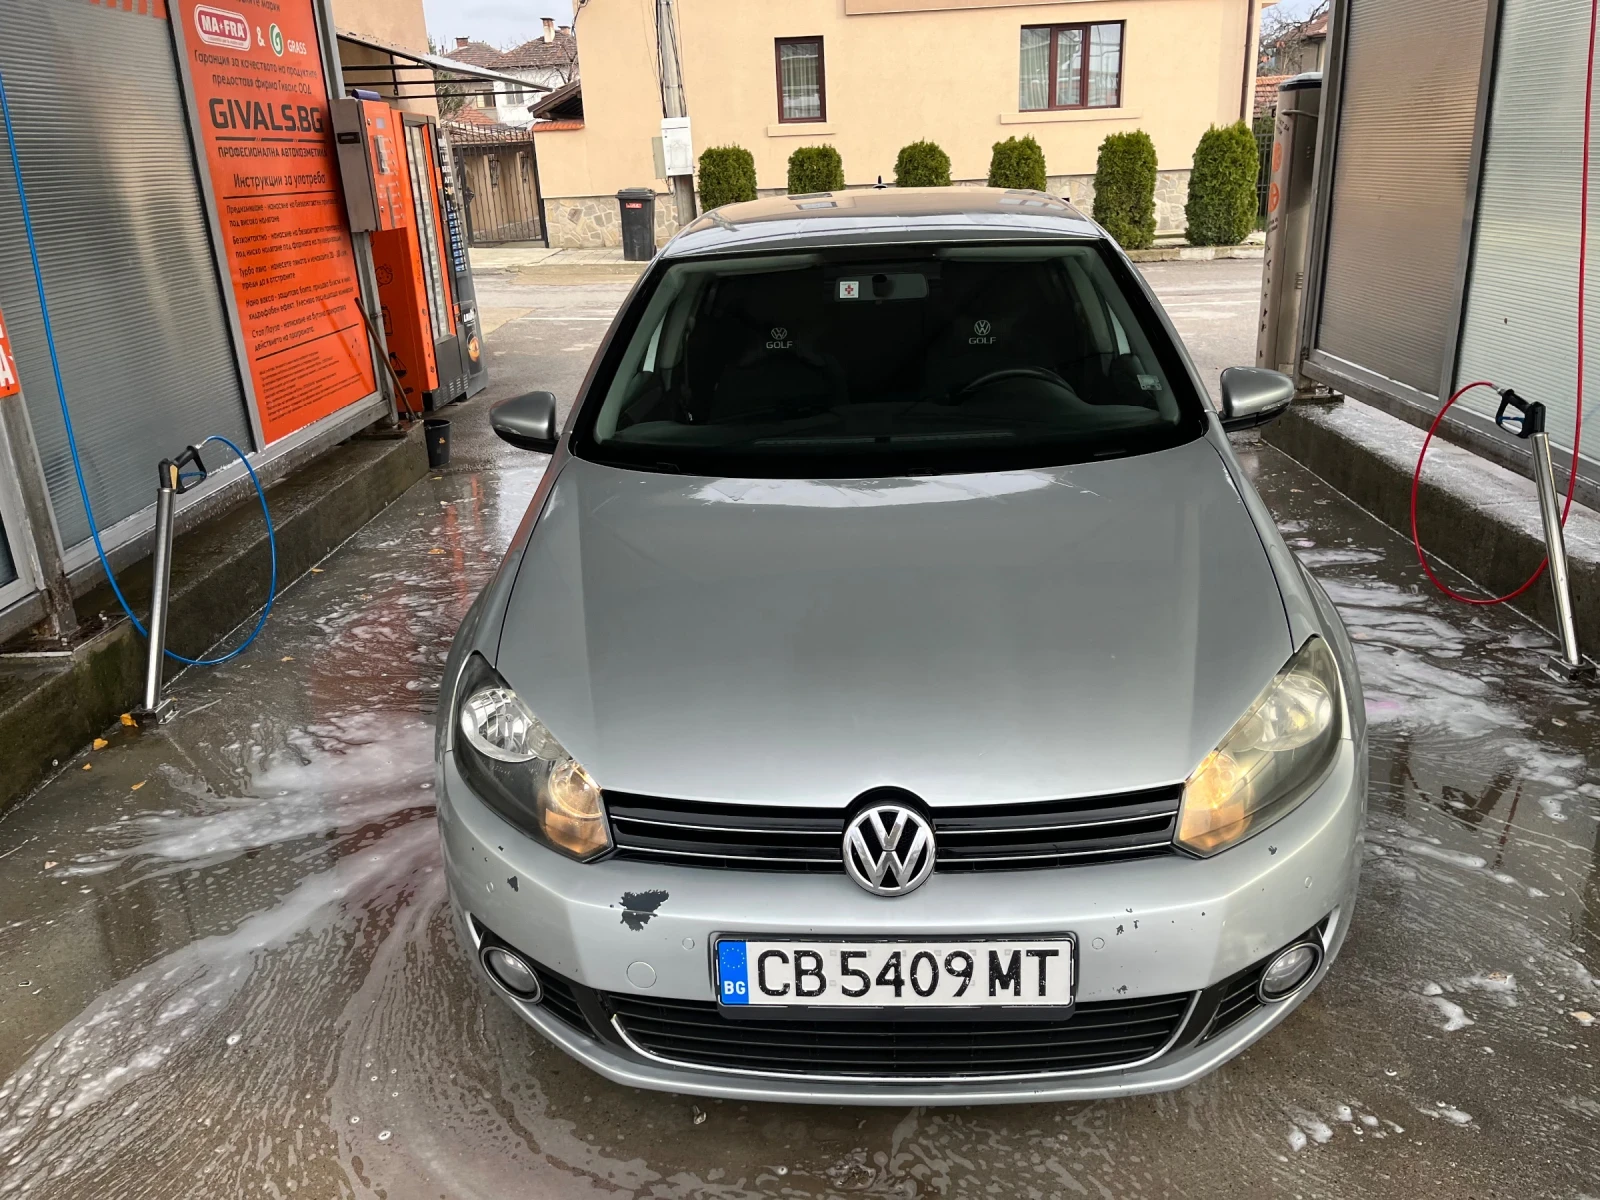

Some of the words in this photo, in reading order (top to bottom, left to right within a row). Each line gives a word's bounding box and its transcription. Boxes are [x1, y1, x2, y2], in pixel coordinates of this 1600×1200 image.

[256, 26, 265, 47] &
[287, 39, 307, 55] GRASS
[194, 50, 230, 67] Гаранция
[231, 58, 240, 67] за
[241, 58, 278, 72] качеството
[278, 65, 286, 73] на
[286, 66, 318, 80] продуктите
[255, 78, 277, 92] фирма
[298, 82, 312, 95] ООД
[209, 98, 325, 133] GIVALS.BG
[218, 147, 280, 158] ПРОФЕСИОНАЛНА
[233, 173, 283, 190] Инструкции
[284, 176, 292, 186] за
[293, 170, 326, 189] употреба
[238, 265, 255, 279] Турбо
[245, 298, 260, 308] Нано
[766, 341, 793, 349] GOLF
[968, 336, 997, 345] GOLF
[724, 981, 746, 995] BG
[757, 949, 827, 997] CB
[840, 949, 975, 998] 5409
[988, 949, 1060, 997] MT
